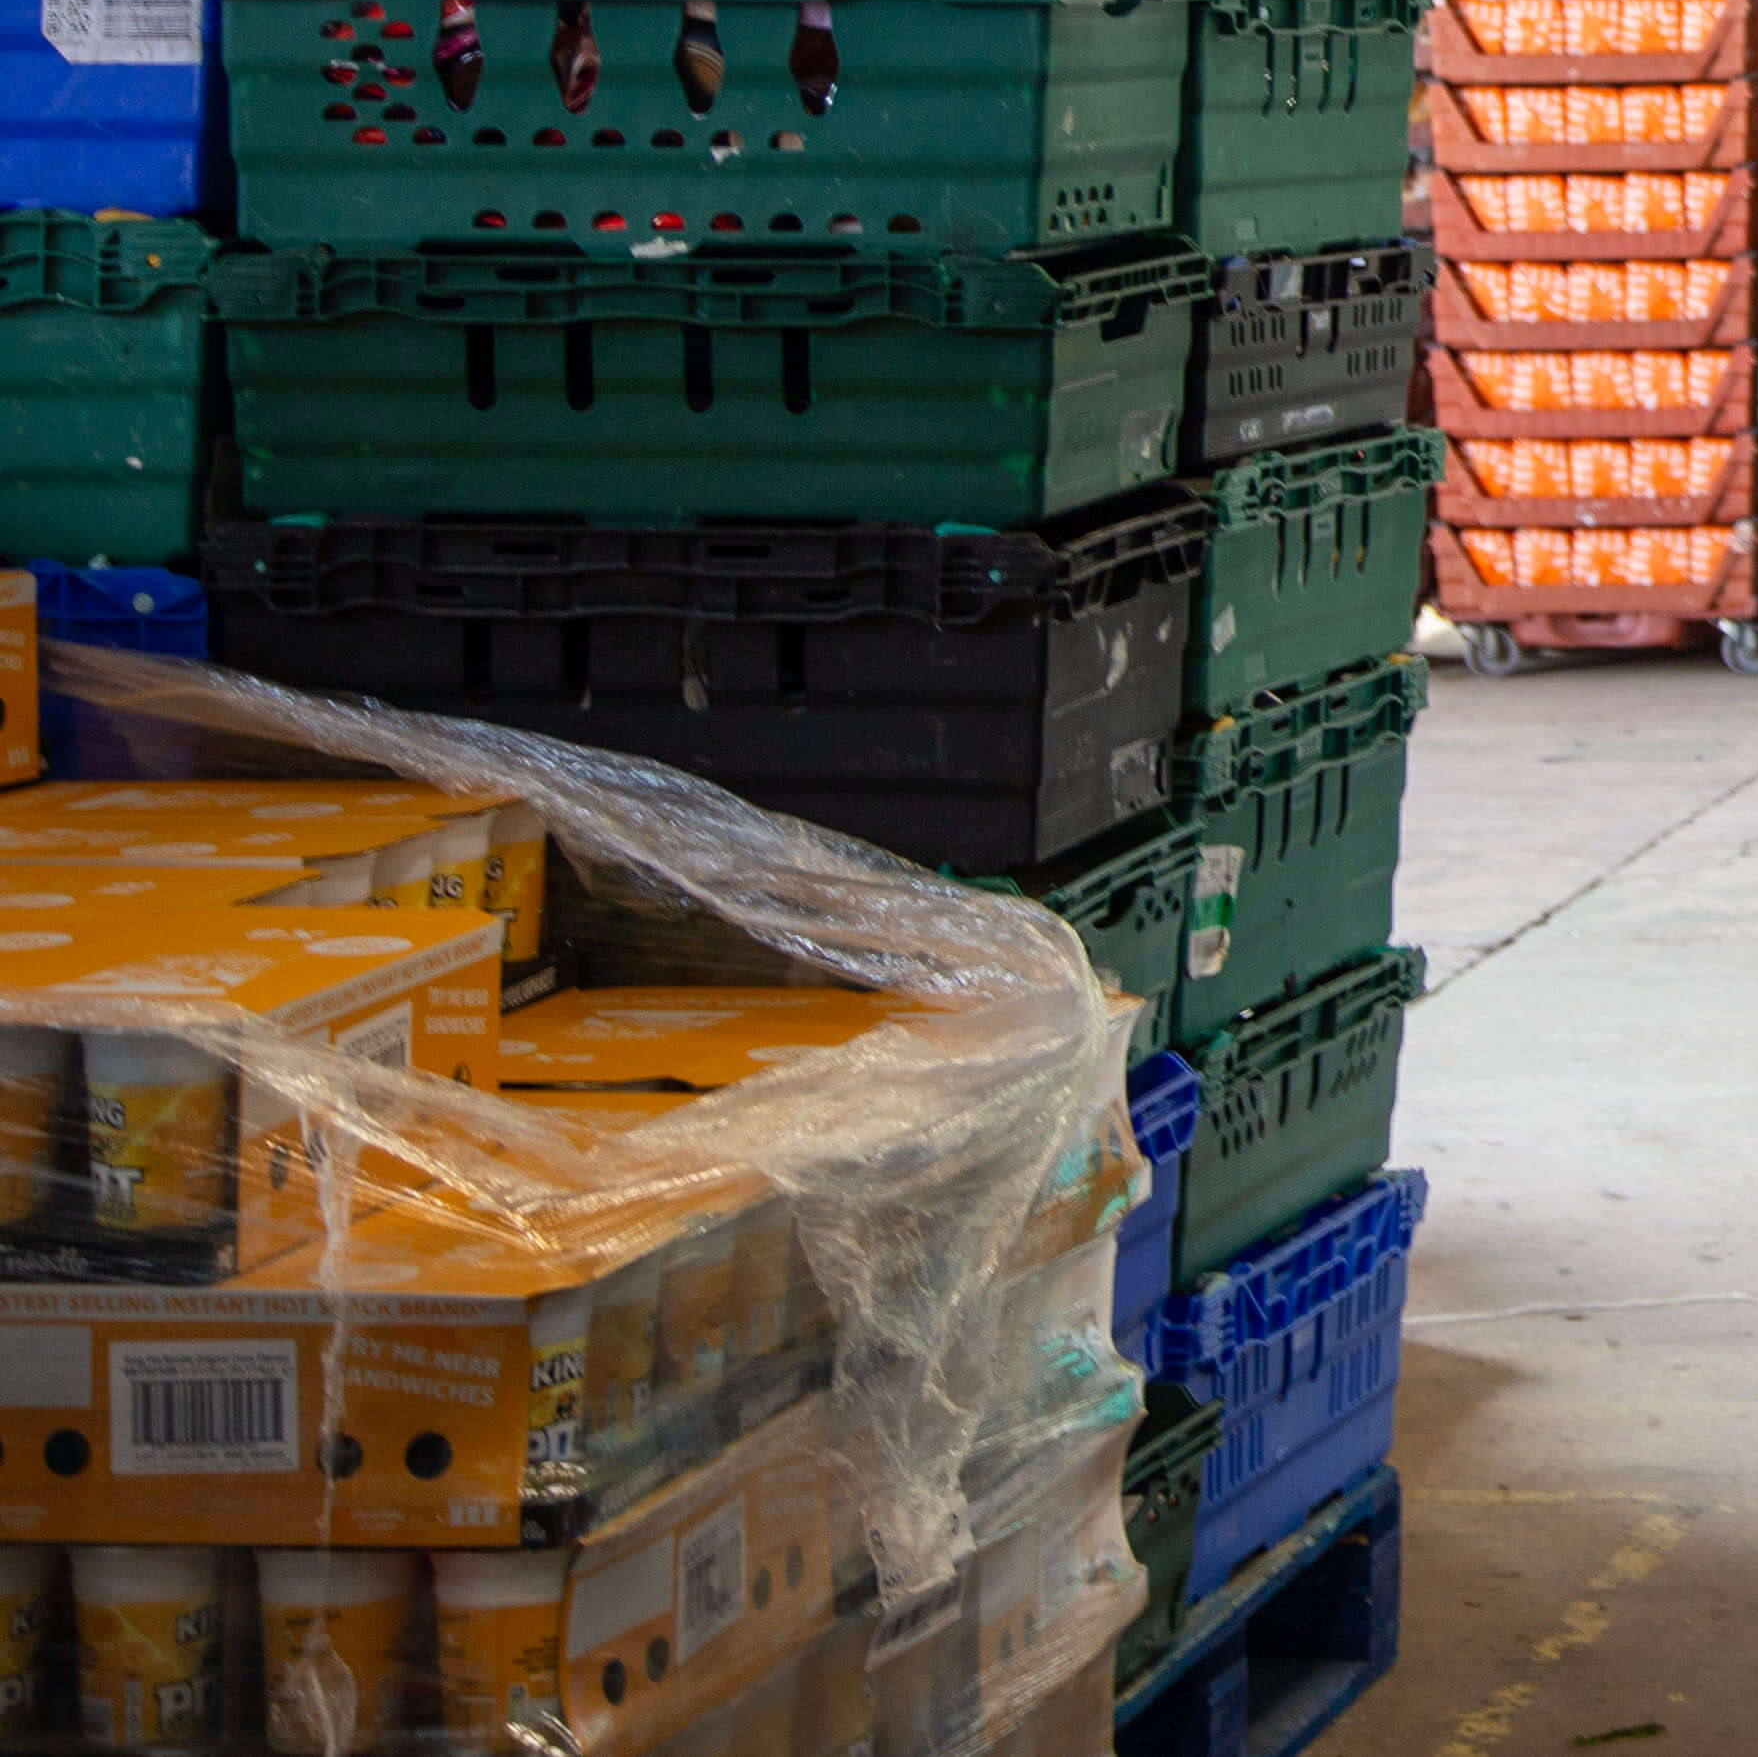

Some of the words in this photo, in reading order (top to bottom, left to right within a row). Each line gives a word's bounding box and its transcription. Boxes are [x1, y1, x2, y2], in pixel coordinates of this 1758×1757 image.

[67, 1294, 157, 1313] SELLING
[163, 1294, 259, 1315] INSTANT
[264, 1295, 312, 1316] HOT
[317, 1297, 392, 1316] SACK
[340, 1336, 386, 1360] RY
[392, 1342, 428, 1367] ME
[433, 1350, 502, 1380] NEAR
[338, 1365, 497, 1409] ANDWICHES
